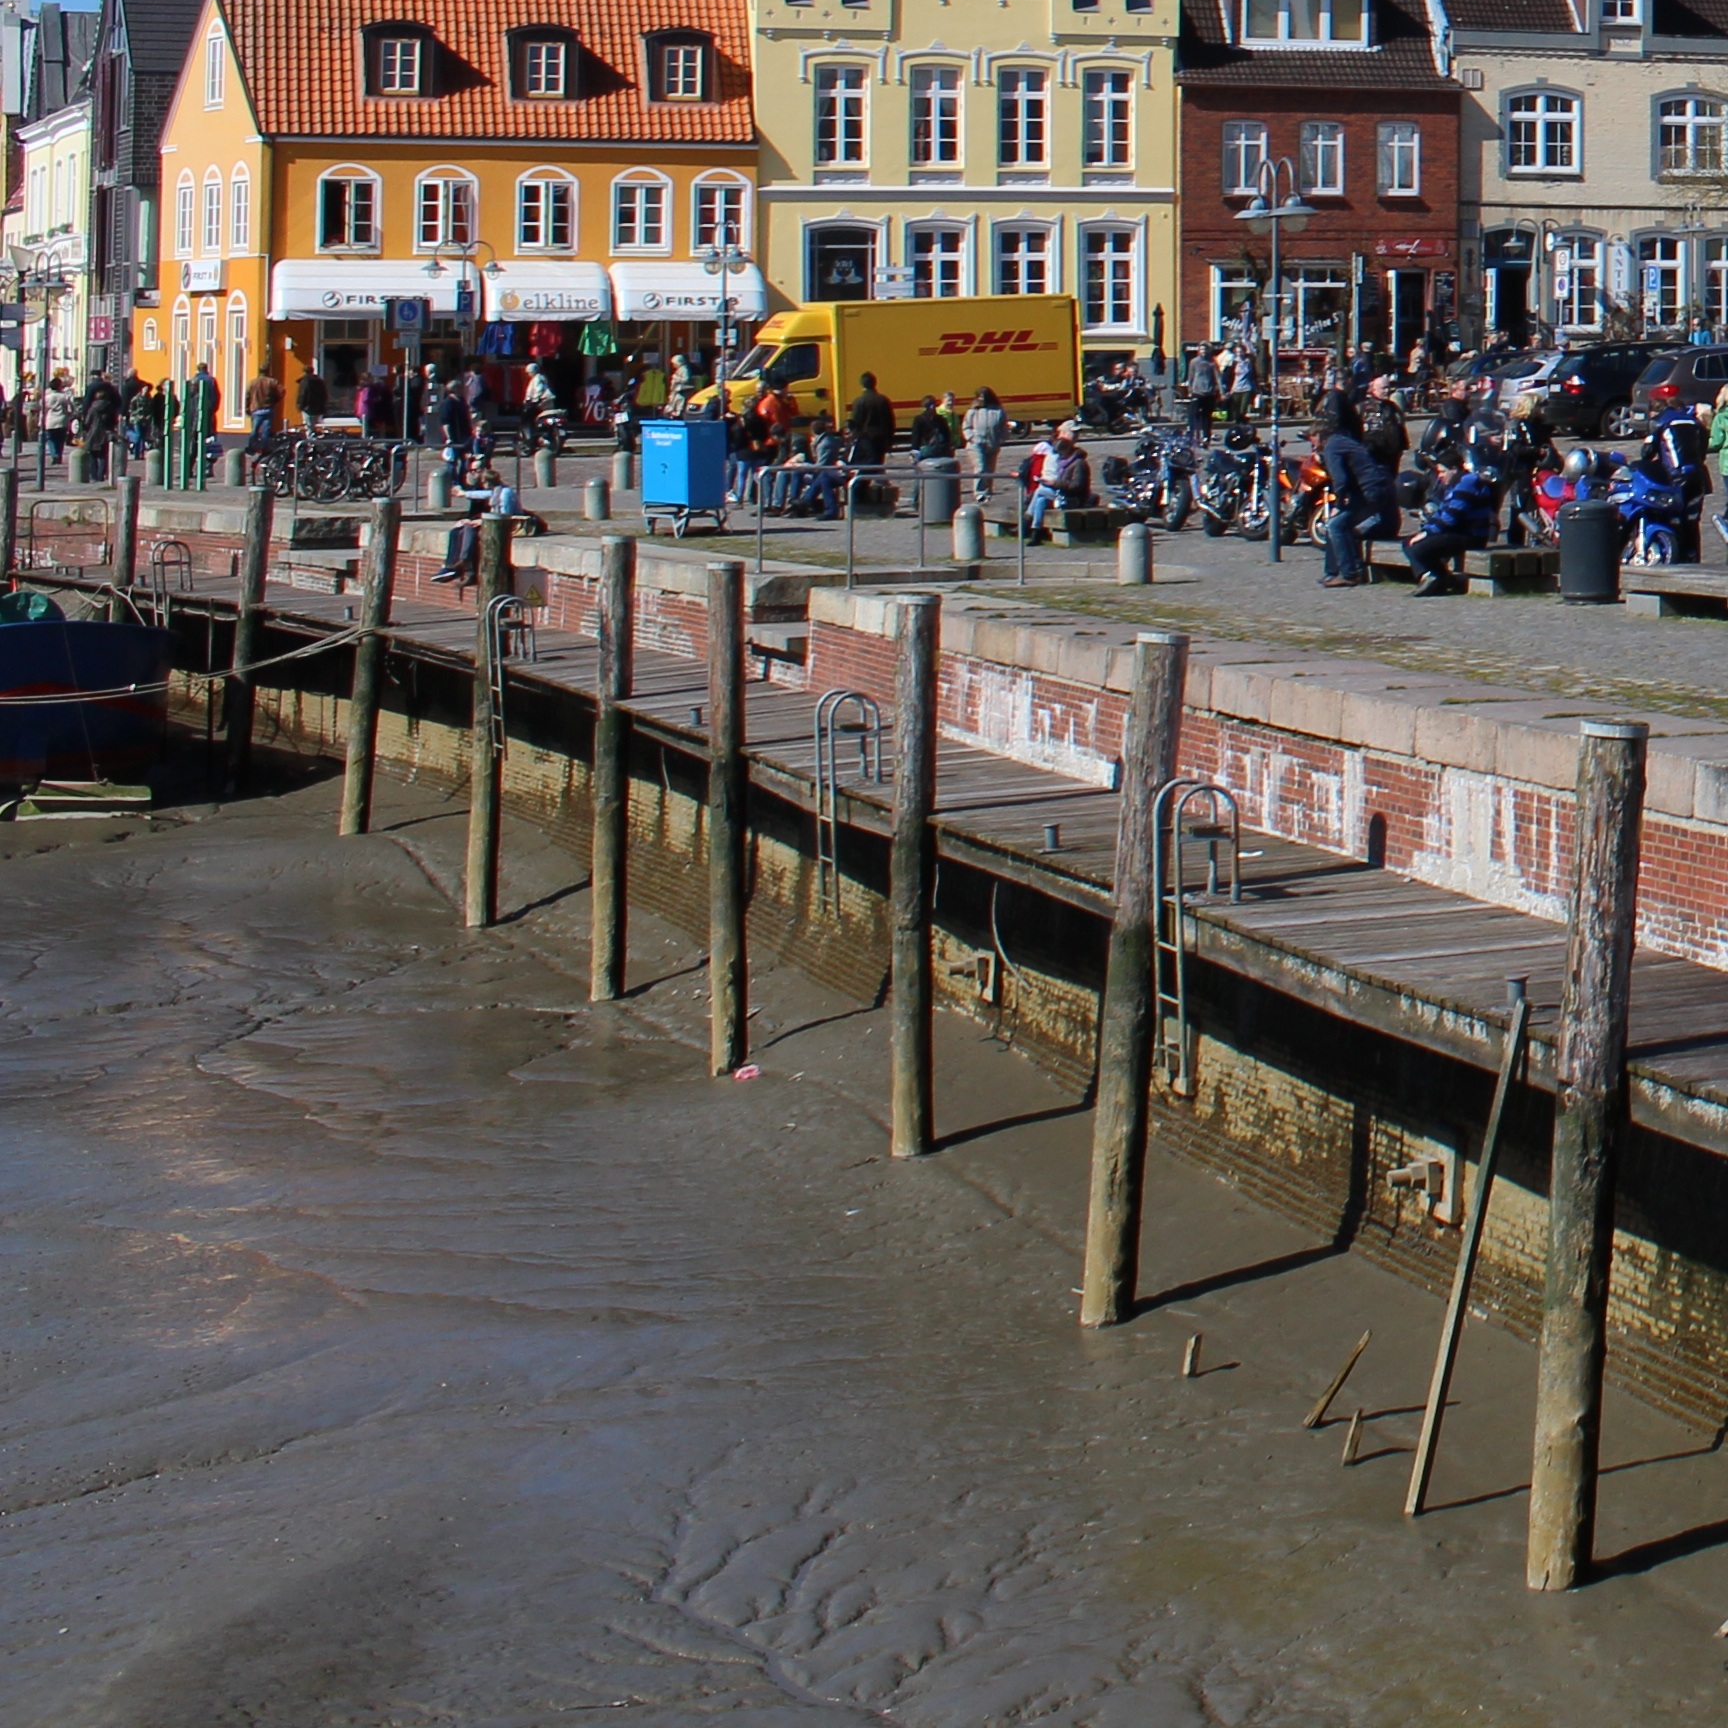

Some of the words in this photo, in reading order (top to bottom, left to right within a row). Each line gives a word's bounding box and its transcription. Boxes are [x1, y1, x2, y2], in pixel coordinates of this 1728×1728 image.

[523, 293, 600, 310] elkline
[665, 296, 717, 306] FIRST
[938, 329, 1041, 356] DHL
